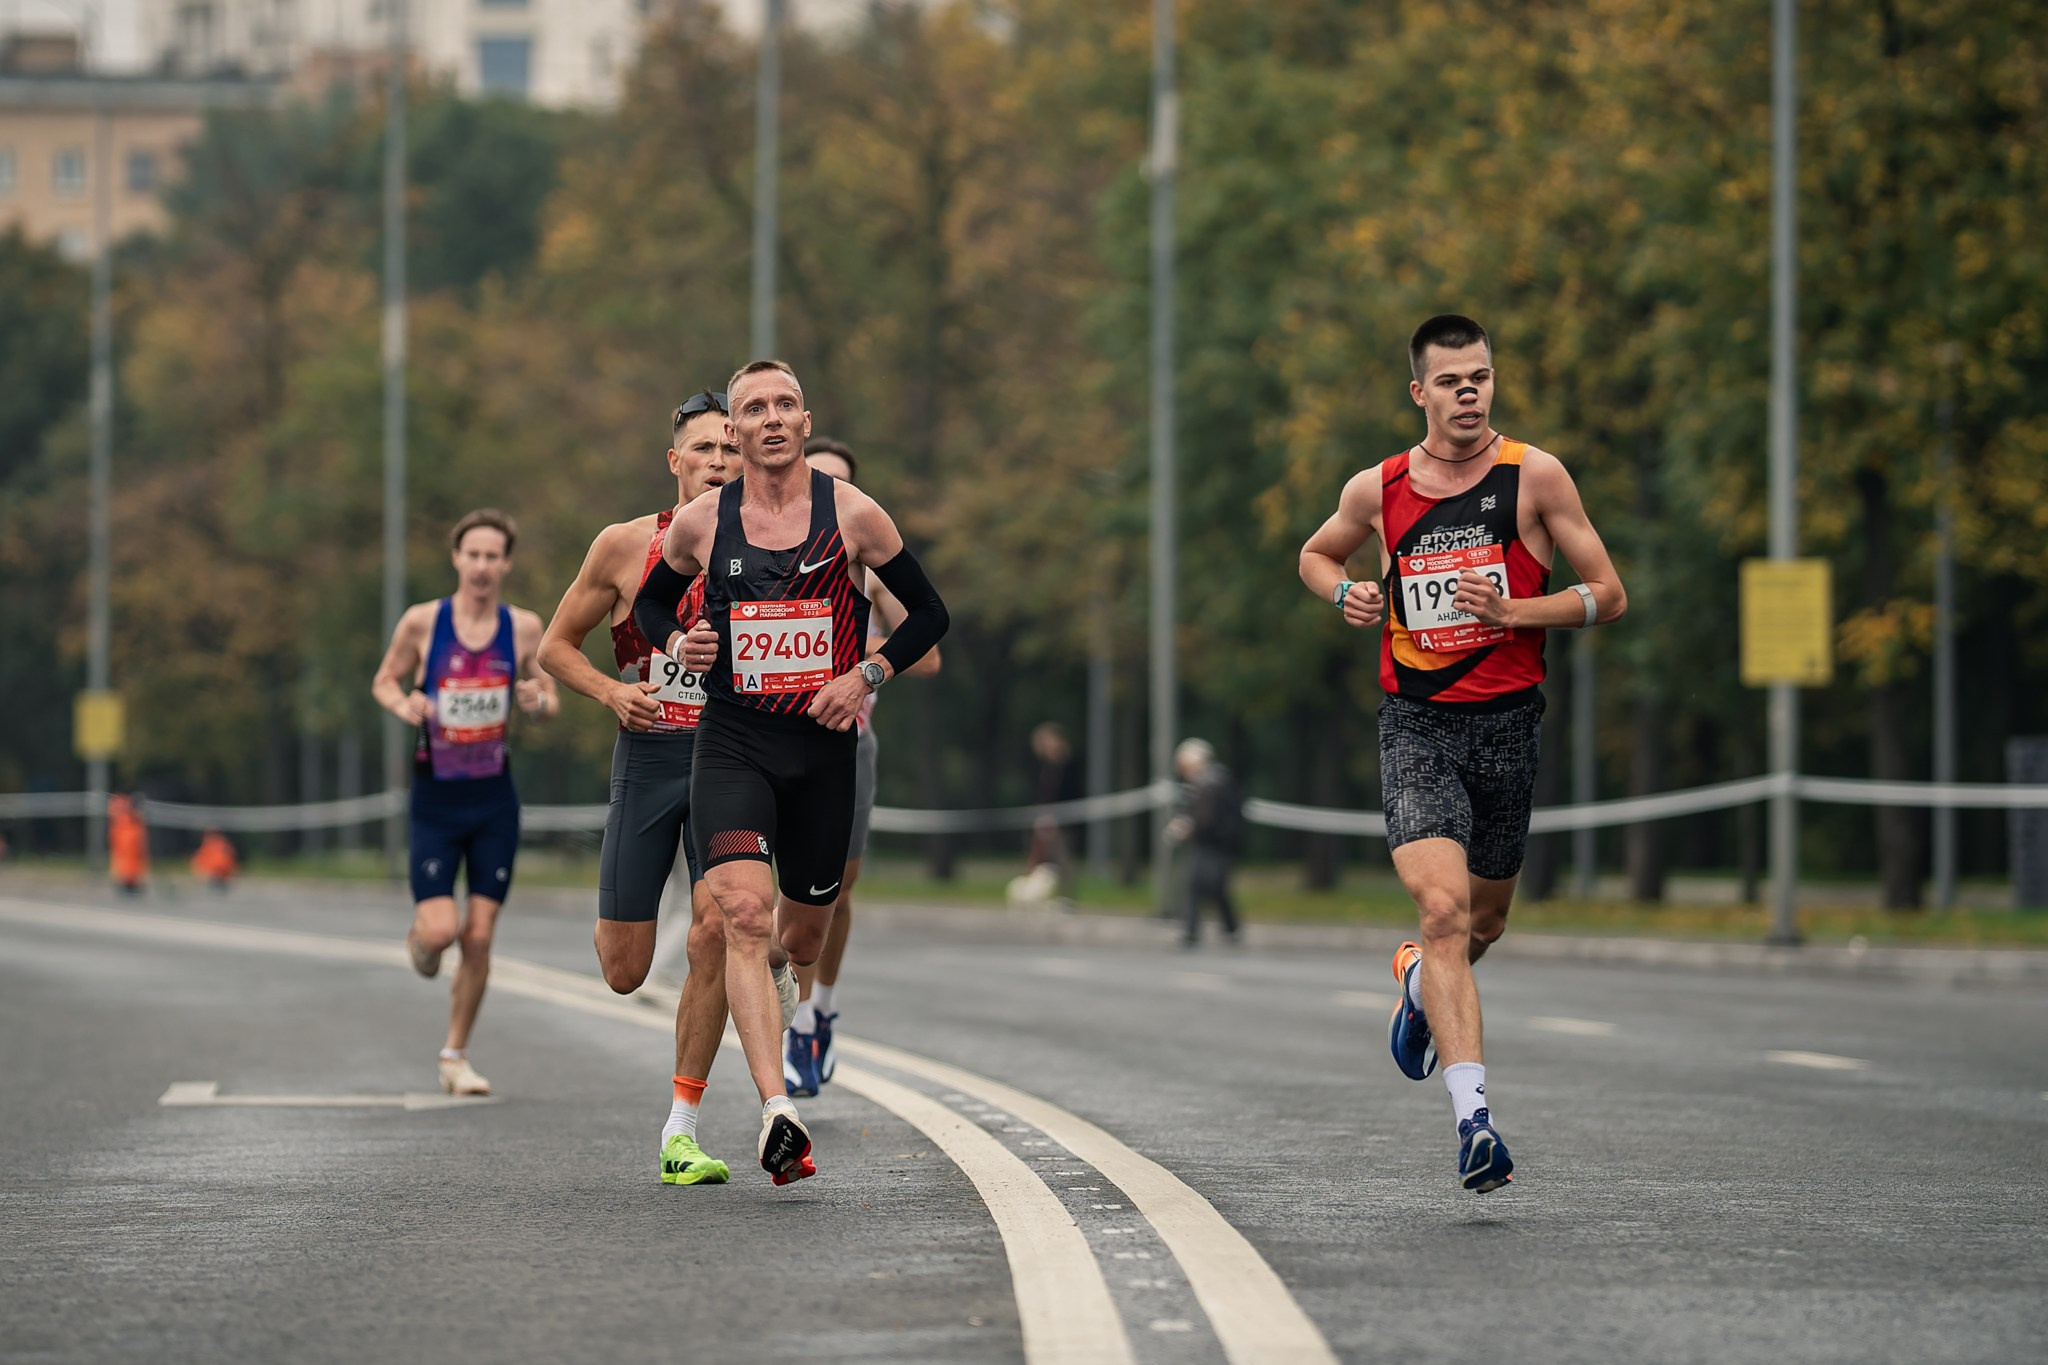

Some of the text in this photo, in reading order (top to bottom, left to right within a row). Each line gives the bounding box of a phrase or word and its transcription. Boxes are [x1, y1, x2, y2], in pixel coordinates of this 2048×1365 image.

[1410, 534, 1494, 557] ДЫХАНИЕ
[1420, 524, 1486, 546] ВТОРОЕ
[1437, 611, 1476, 622] АНДРЕ
[736, 629, 829, 661] 29406
[663, 661, 705, 688] 96
[678, 690, 708, 701] СТЕПА
